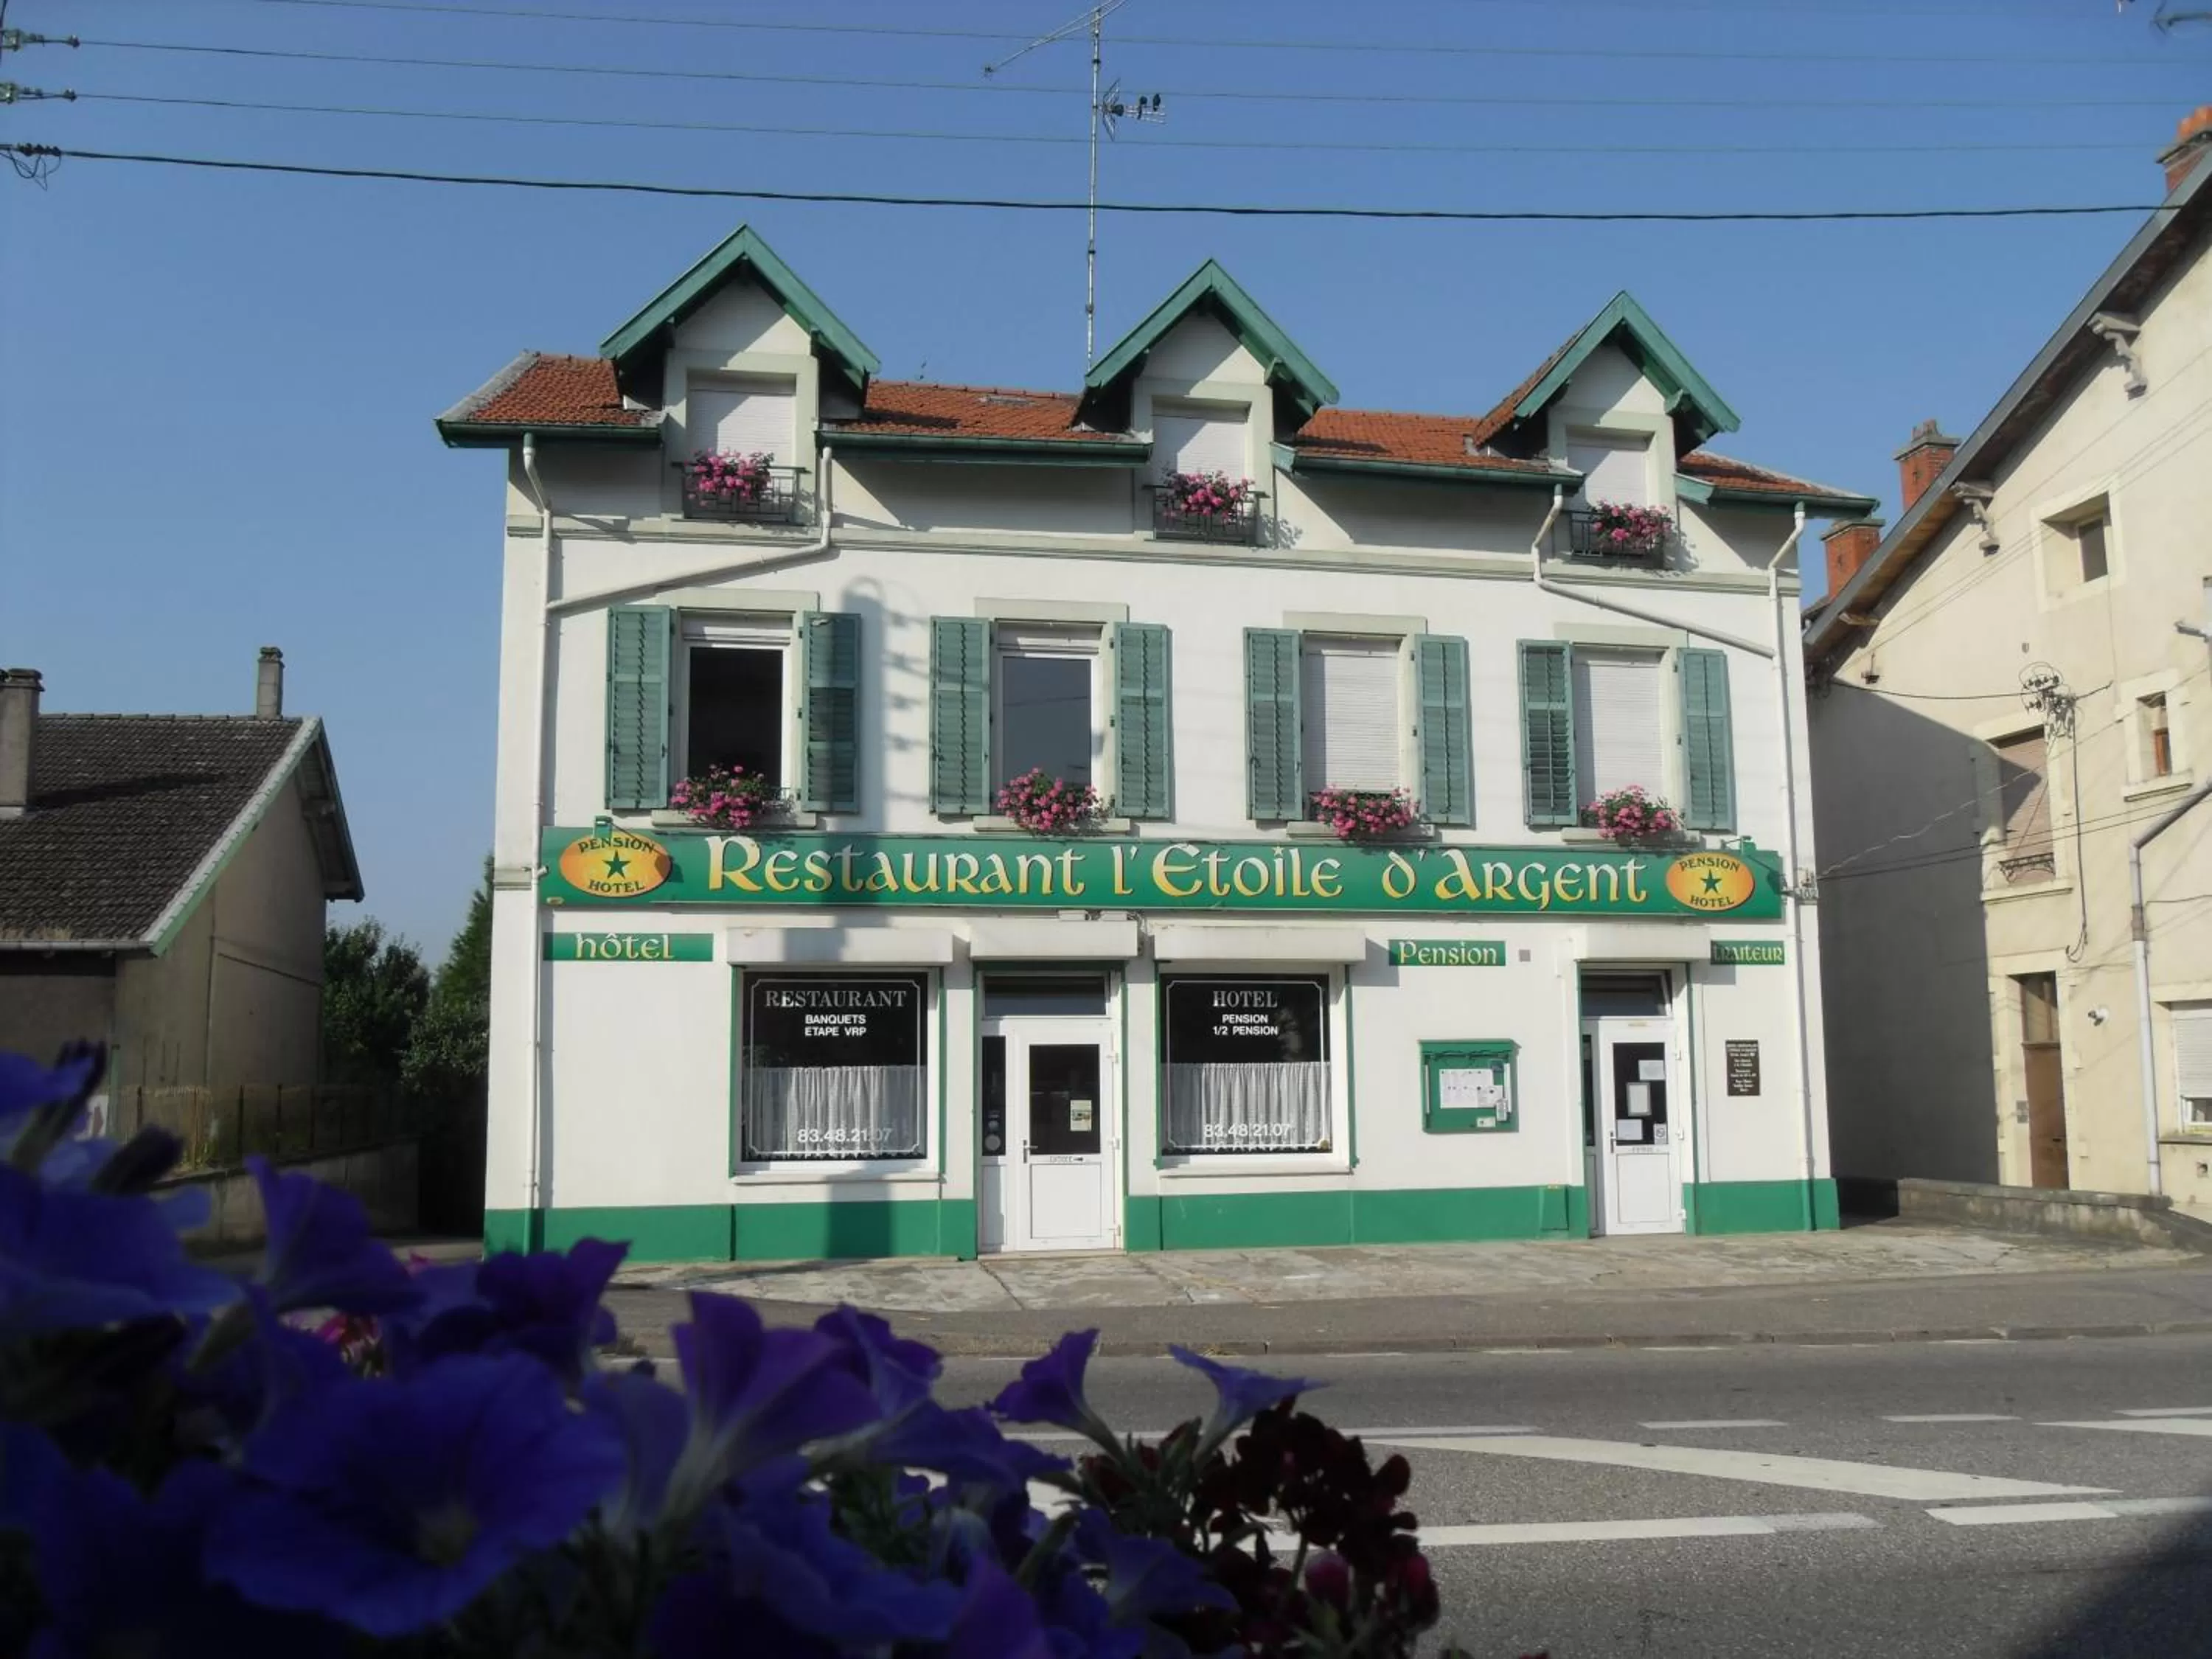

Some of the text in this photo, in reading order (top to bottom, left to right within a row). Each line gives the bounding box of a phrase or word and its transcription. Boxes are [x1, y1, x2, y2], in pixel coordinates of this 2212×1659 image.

[577, 837, 655, 853] PENSION
[1679, 858, 1741, 872] PENSION
[704, 835, 1086, 897] Restaurant
[1381, 849, 1648, 911] d'Argent
[588, 880, 644, 893] HOTEL
[1690, 894, 1734, 908] HOTEL
[574, 932, 675, 959] hôtel
[1398, 940, 1498, 964] Pension
[765, 990, 907, 1007] RESTAURANT
[1212, 990, 1278, 1008] HOTEL
[804, 1014, 866, 1024] BANQUETS
[1222, 1014, 1268, 1024] PENSION
[804, 1026, 867, 1036] ETAPE VRP
[1212, 1026, 1278, 1036] 1/2 PENSION
